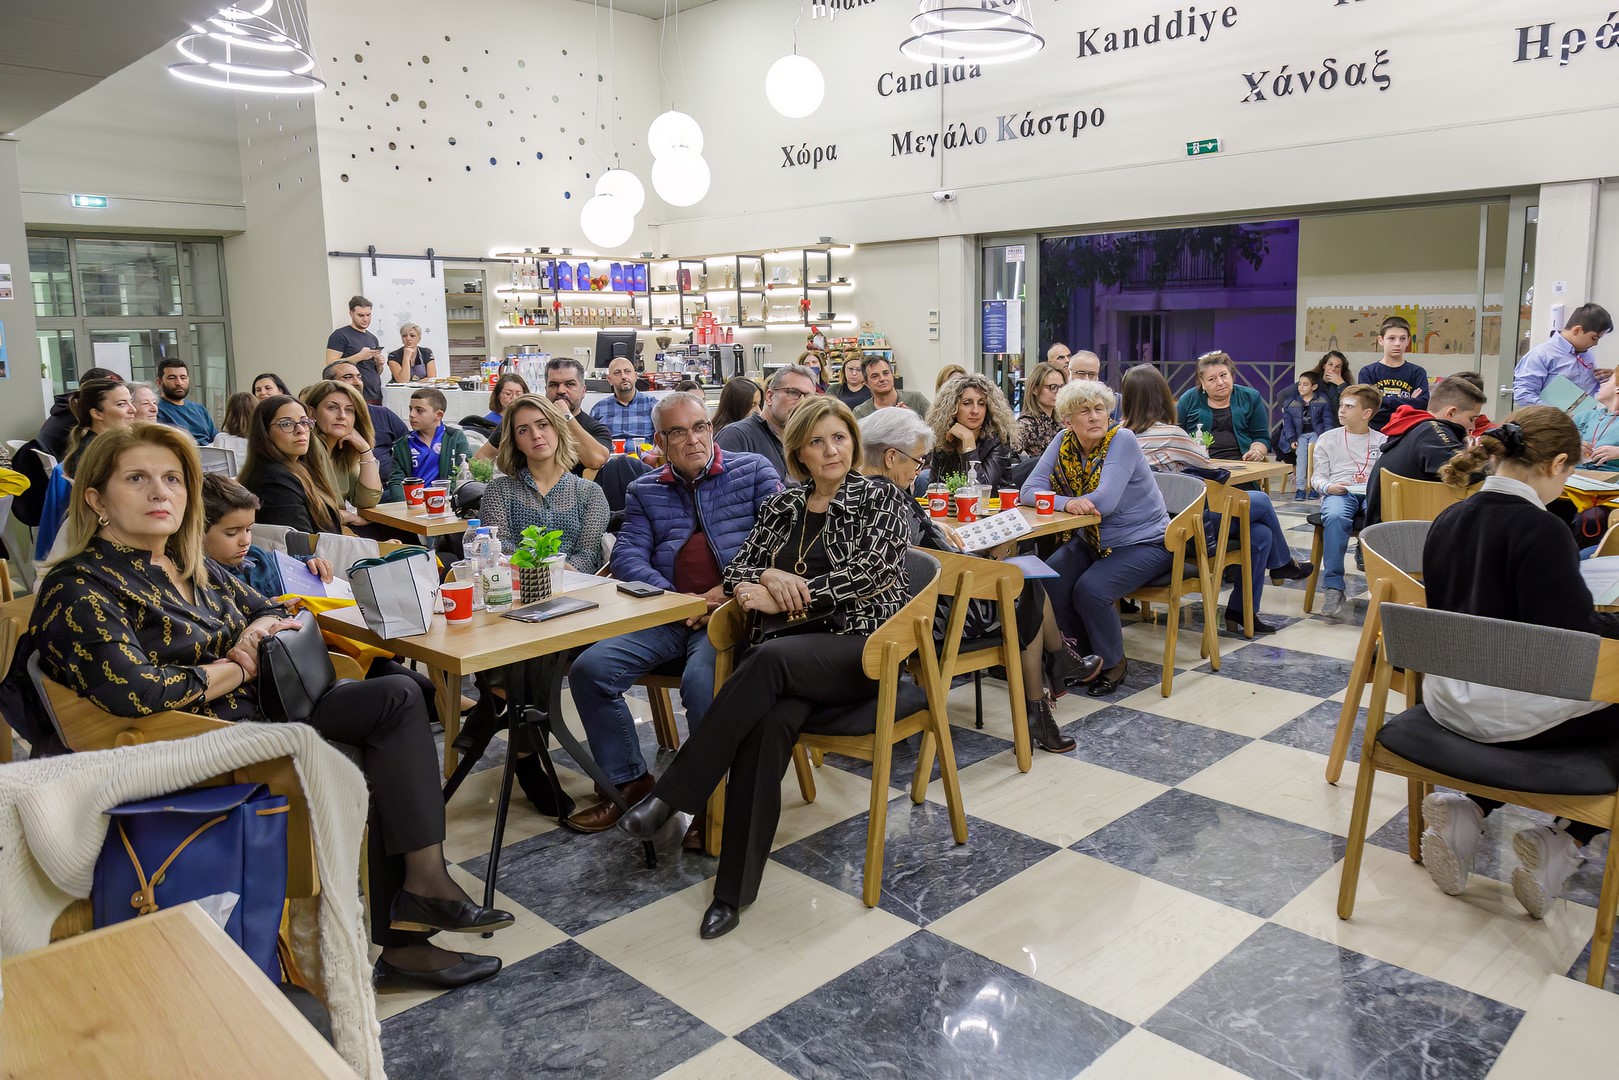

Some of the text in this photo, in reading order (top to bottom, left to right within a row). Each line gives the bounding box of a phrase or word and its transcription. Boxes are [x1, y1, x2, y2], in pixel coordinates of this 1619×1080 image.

[1076, 6, 1238, 58] Kanddiye
[877, 56, 982, 97] Candida
[1240, 49, 1391, 104] Χάνδαξ
[781, 142, 838, 170] Χώρα
[890, 107, 1106, 158] Μεγάλο Κάστρο
